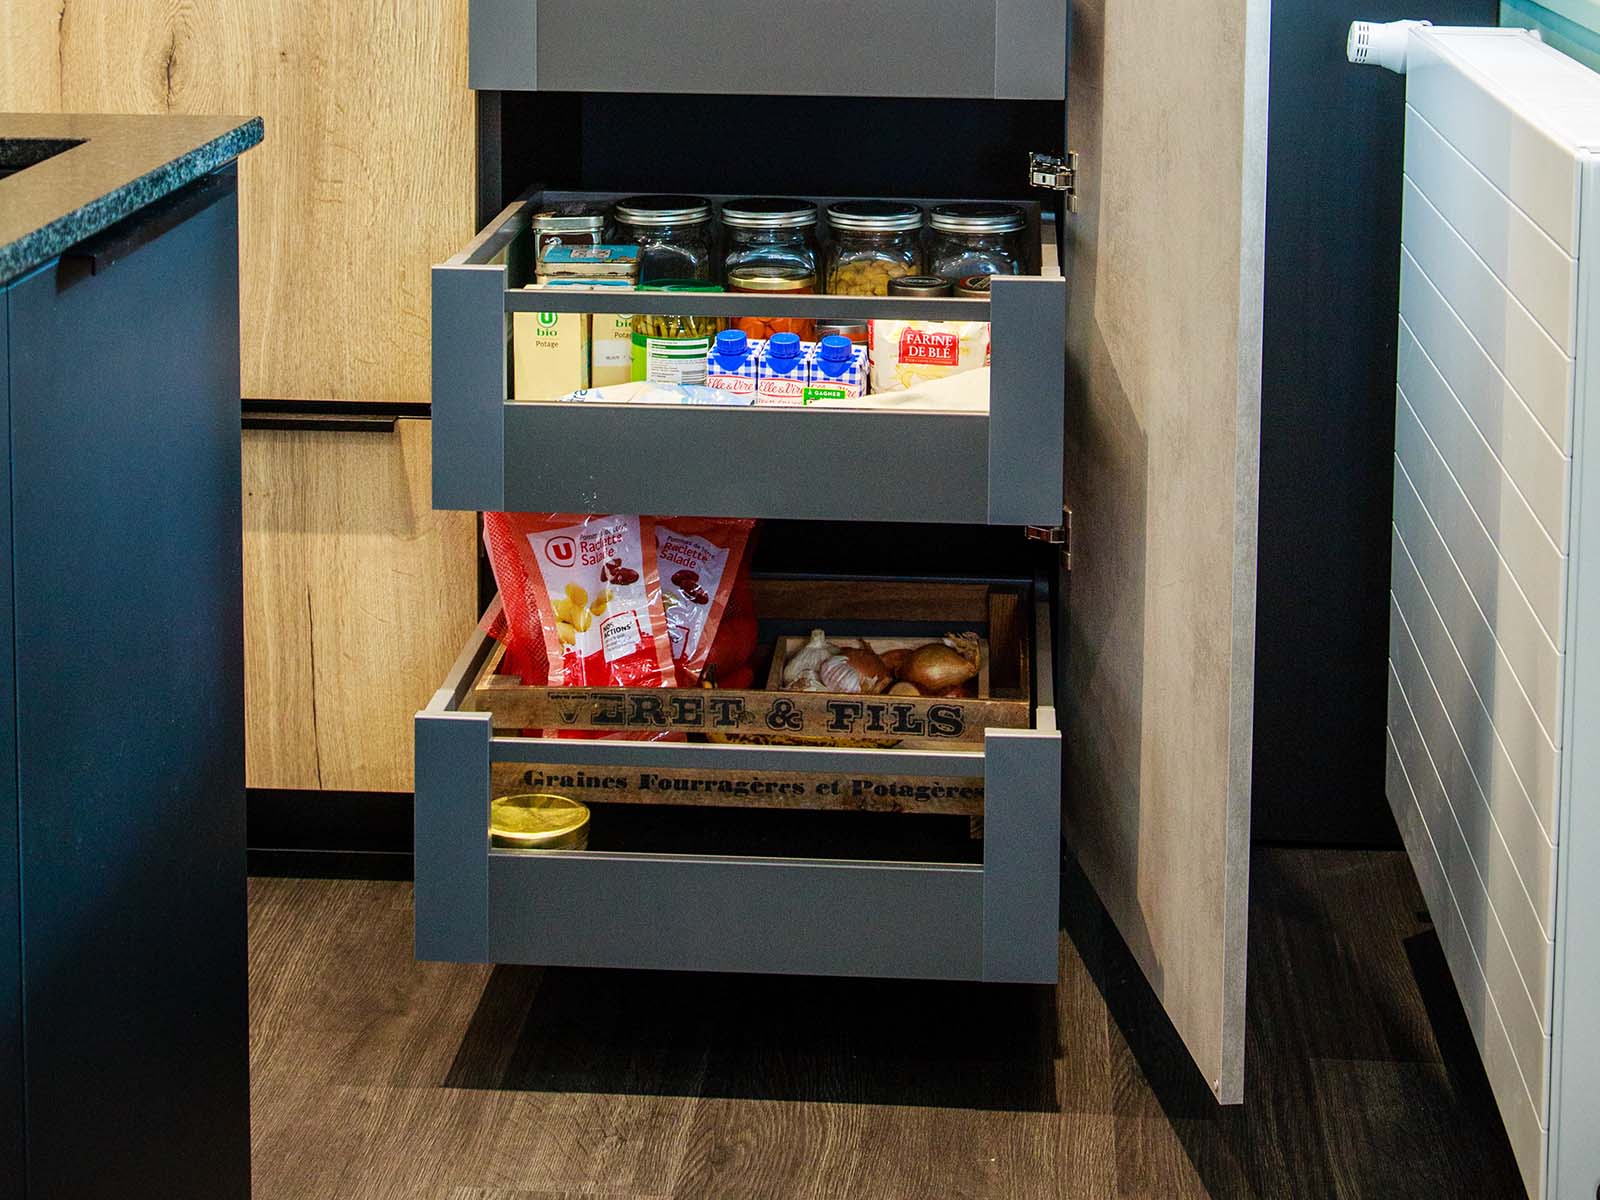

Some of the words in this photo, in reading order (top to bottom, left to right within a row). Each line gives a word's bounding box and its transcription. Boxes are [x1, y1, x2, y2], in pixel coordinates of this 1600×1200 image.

[536, 328, 558, 337] bio
[614, 331, 632, 339] Pota
[906, 333, 953, 346] FARINE
[535, 340, 559, 349] Potage
[909, 345, 926, 358] DE
[928, 343, 951, 359] BLÉ
[552, 542, 573, 561] U
[581, 533, 624, 554] Raclette
[663, 542, 709, 563] Raclette
[659, 550, 697, 569] Salade
[766, 698, 804, 731] &
[826, 699, 966, 738] FILS
[523, 769, 628, 791] Graines
[639, 773, 805, 797] Fourragères
[815, 779, 842, 797] et
